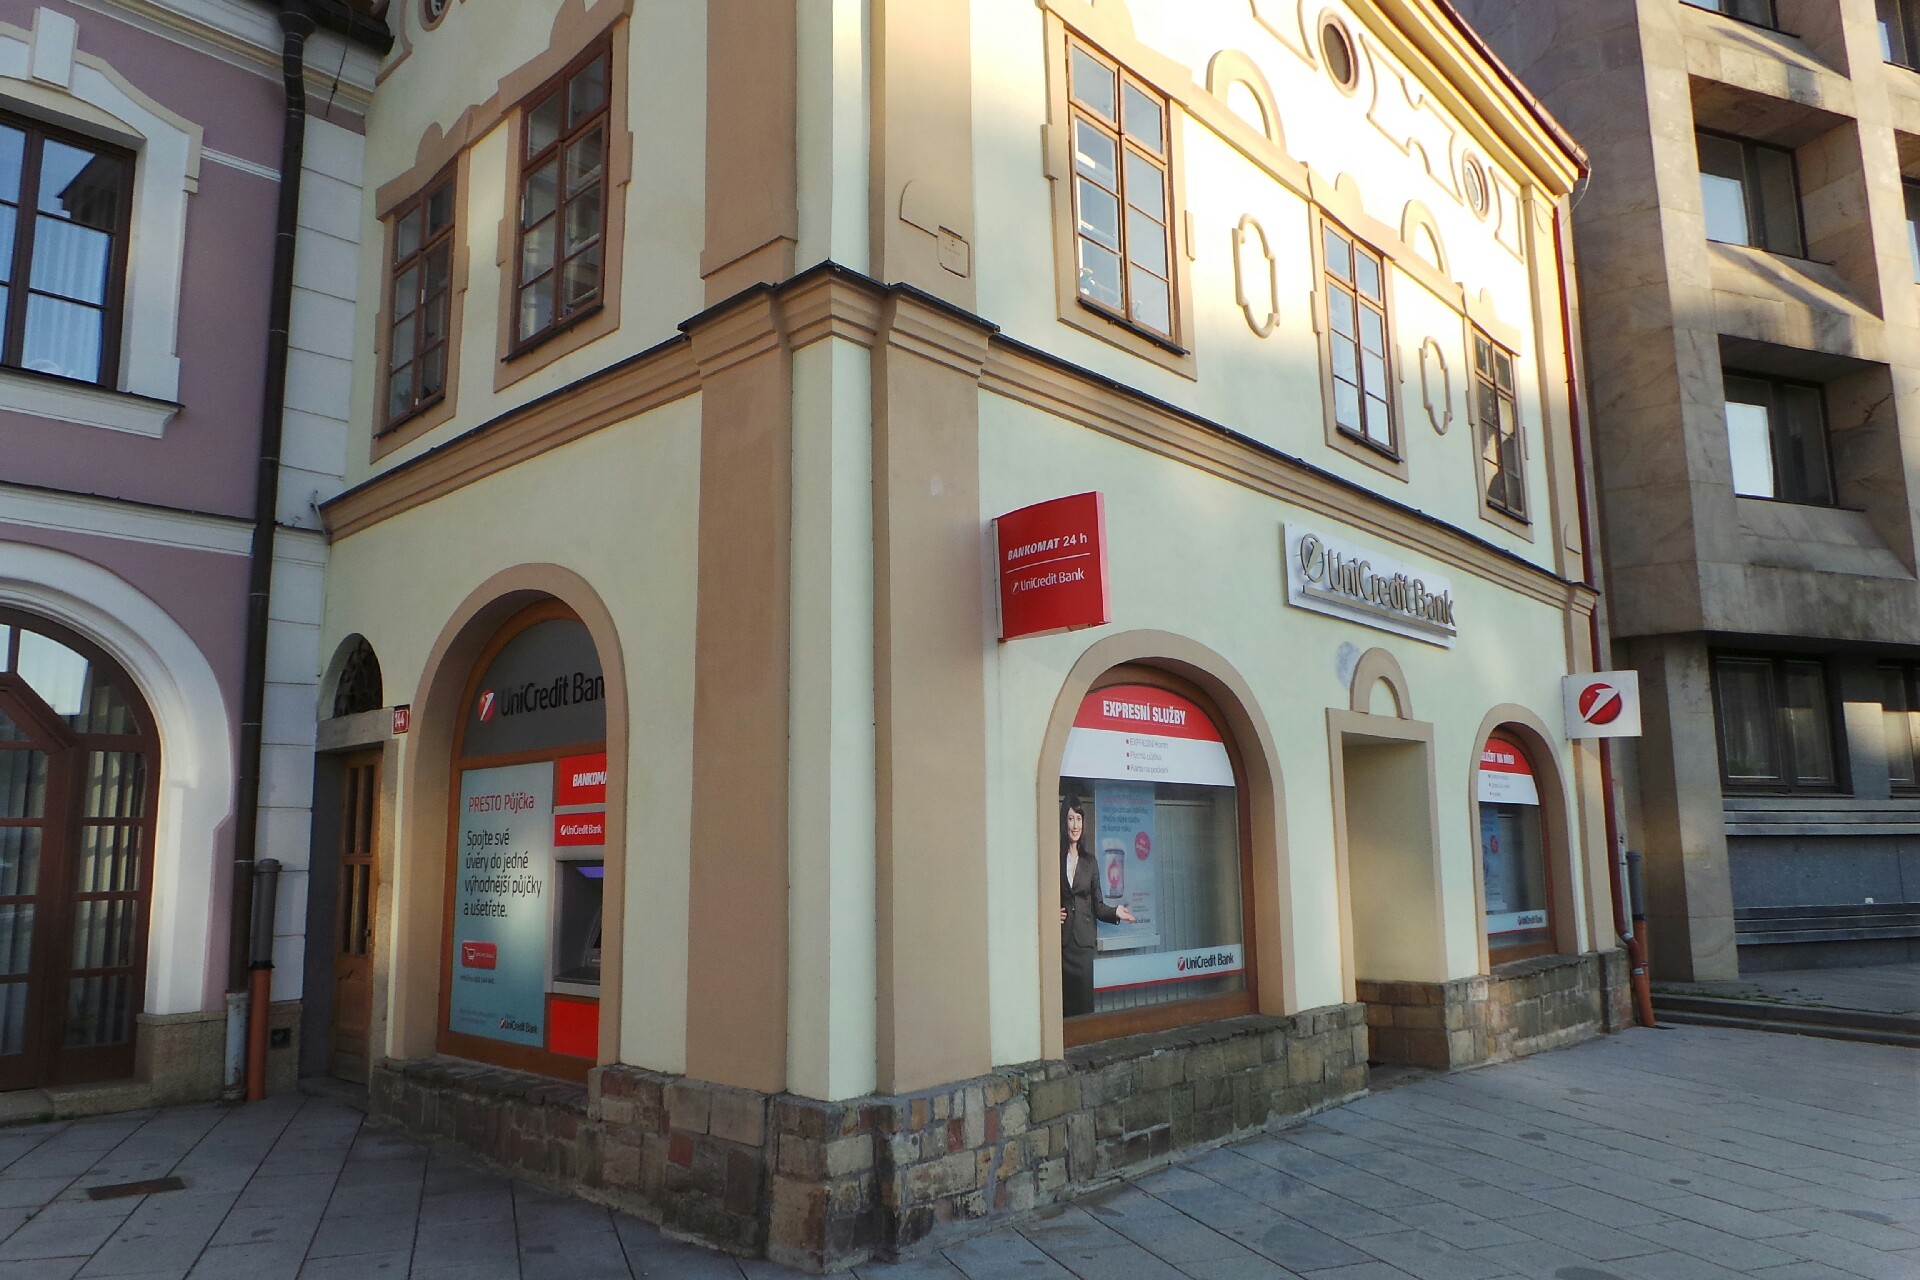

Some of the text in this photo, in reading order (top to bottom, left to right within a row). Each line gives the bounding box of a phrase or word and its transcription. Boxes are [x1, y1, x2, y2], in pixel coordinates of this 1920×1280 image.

[1007, 533, 1087, 561] BANKOMAT 24 h
[1020, 567, 1085, 592] UniCredit Bank
[1328, 549, 1456, 627] UniCredit Bank
[501, 675, 569, 716] UniCredit
[1103, 700, 1186, 725] EXPRESNÍ SLUŽBY
[468, 792, 534, 817] PRESTO Půjčka
[466, 830, 510, 850] Spojte své
[566, 823, 602, 835] UniCredit Bank
[465, 851, 529, 872] úvěry do jedné
[465, 874, 542, 898] výhodnější půjčky
[463, 900, 508, 918] a ušetřete.
[1186, 953, 1234, 970] UniCredit Bank
